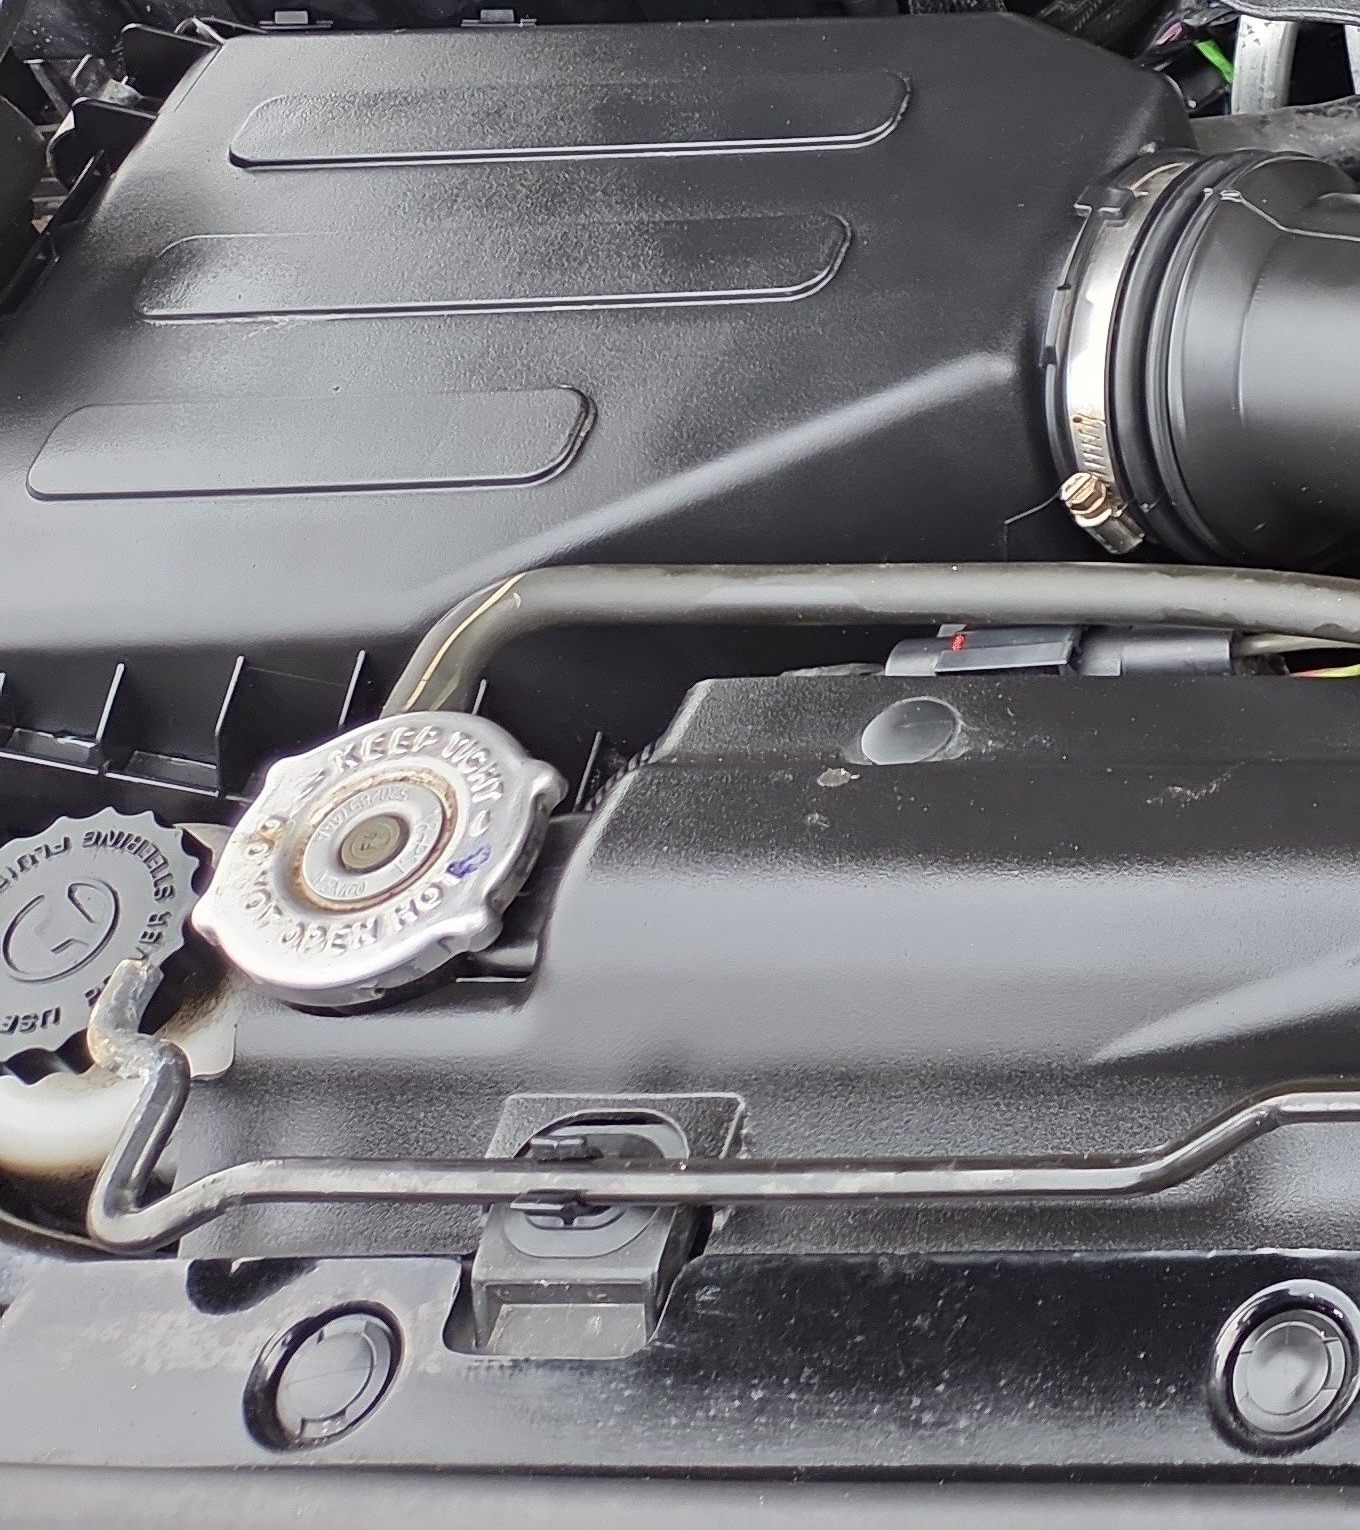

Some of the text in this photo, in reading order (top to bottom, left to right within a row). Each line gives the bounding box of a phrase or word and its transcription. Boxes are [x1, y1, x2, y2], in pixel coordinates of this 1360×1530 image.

[331, 725, 505, 803] KEEP TIGHT
[281, 917, 381, 956] OPEN
